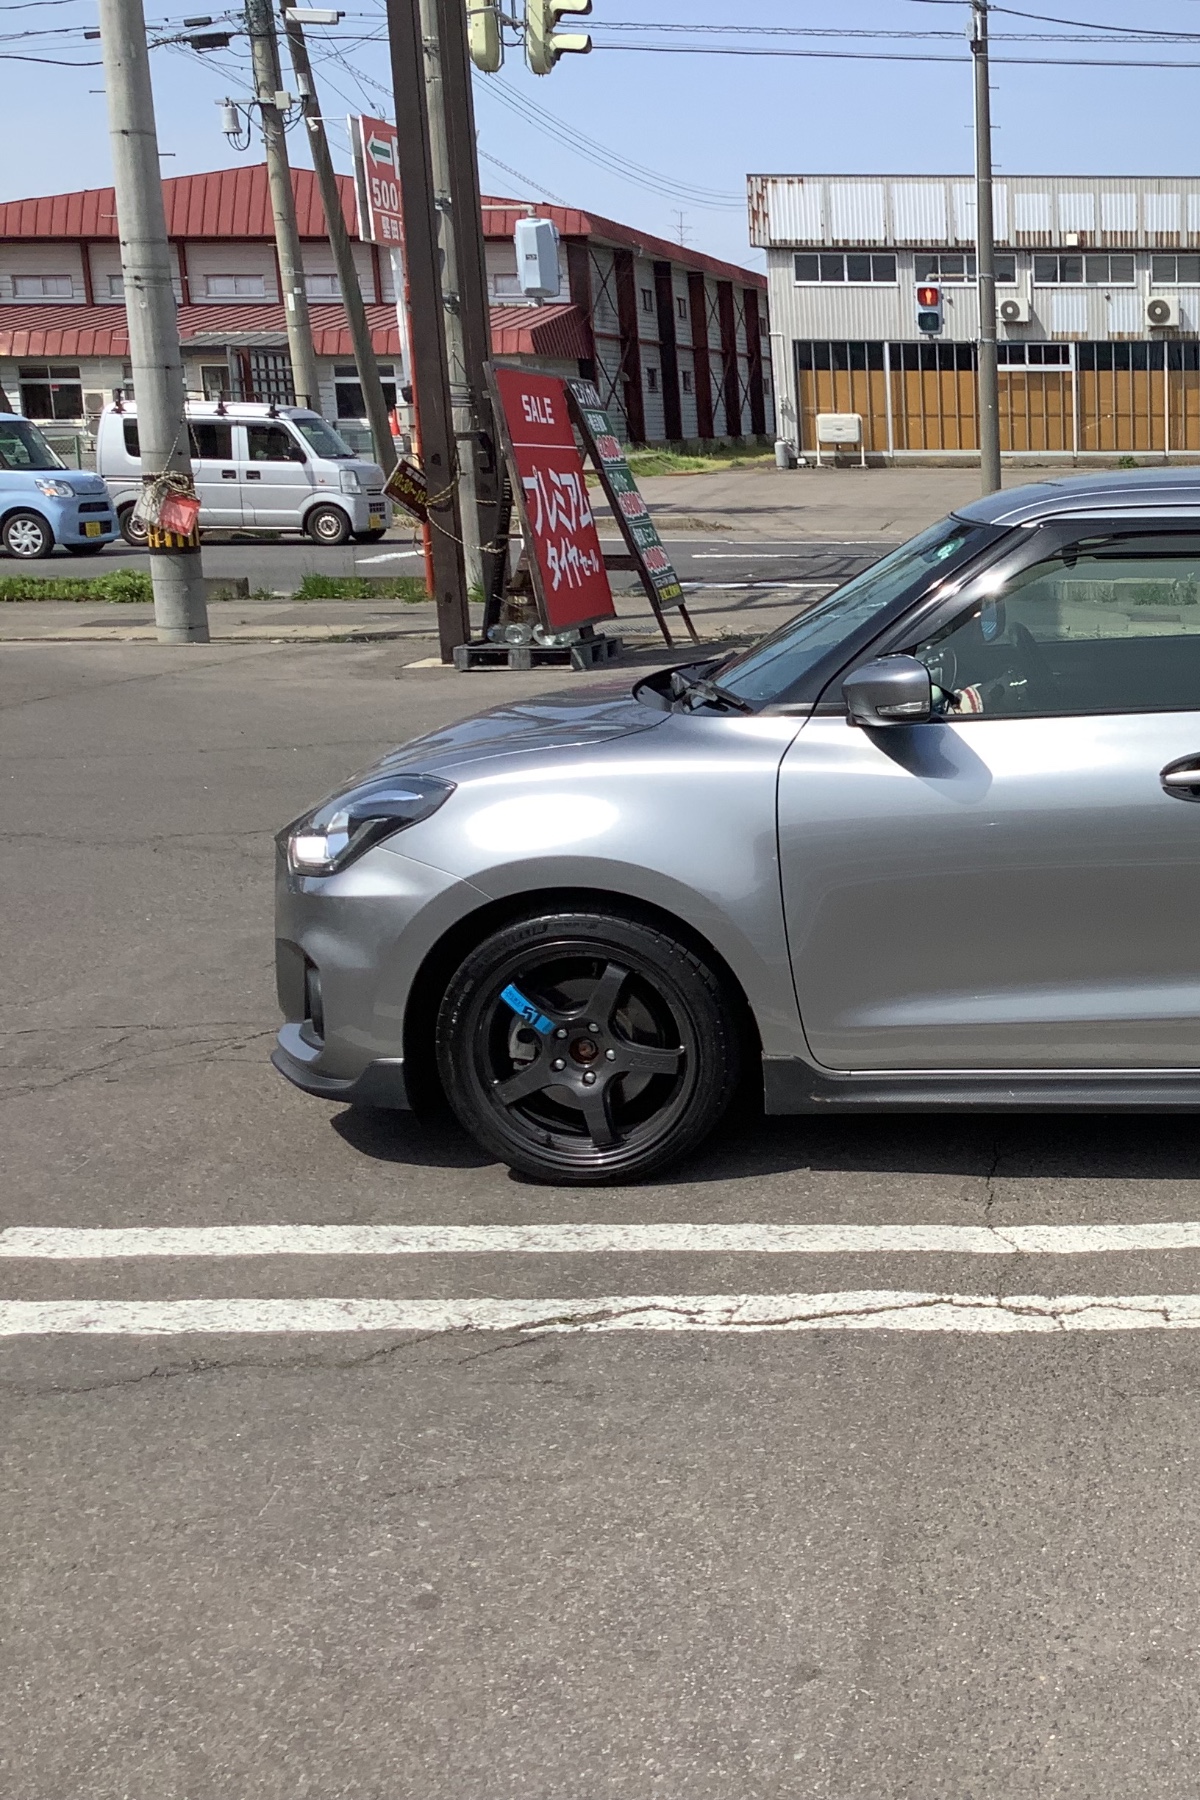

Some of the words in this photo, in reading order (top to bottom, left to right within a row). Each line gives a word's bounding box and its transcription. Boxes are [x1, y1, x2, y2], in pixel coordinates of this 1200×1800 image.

[521, 394, 555, 424] SALE
[522, 465, 594, 537] プレミアム
[546, 537, 600, 592] タイヤセール
